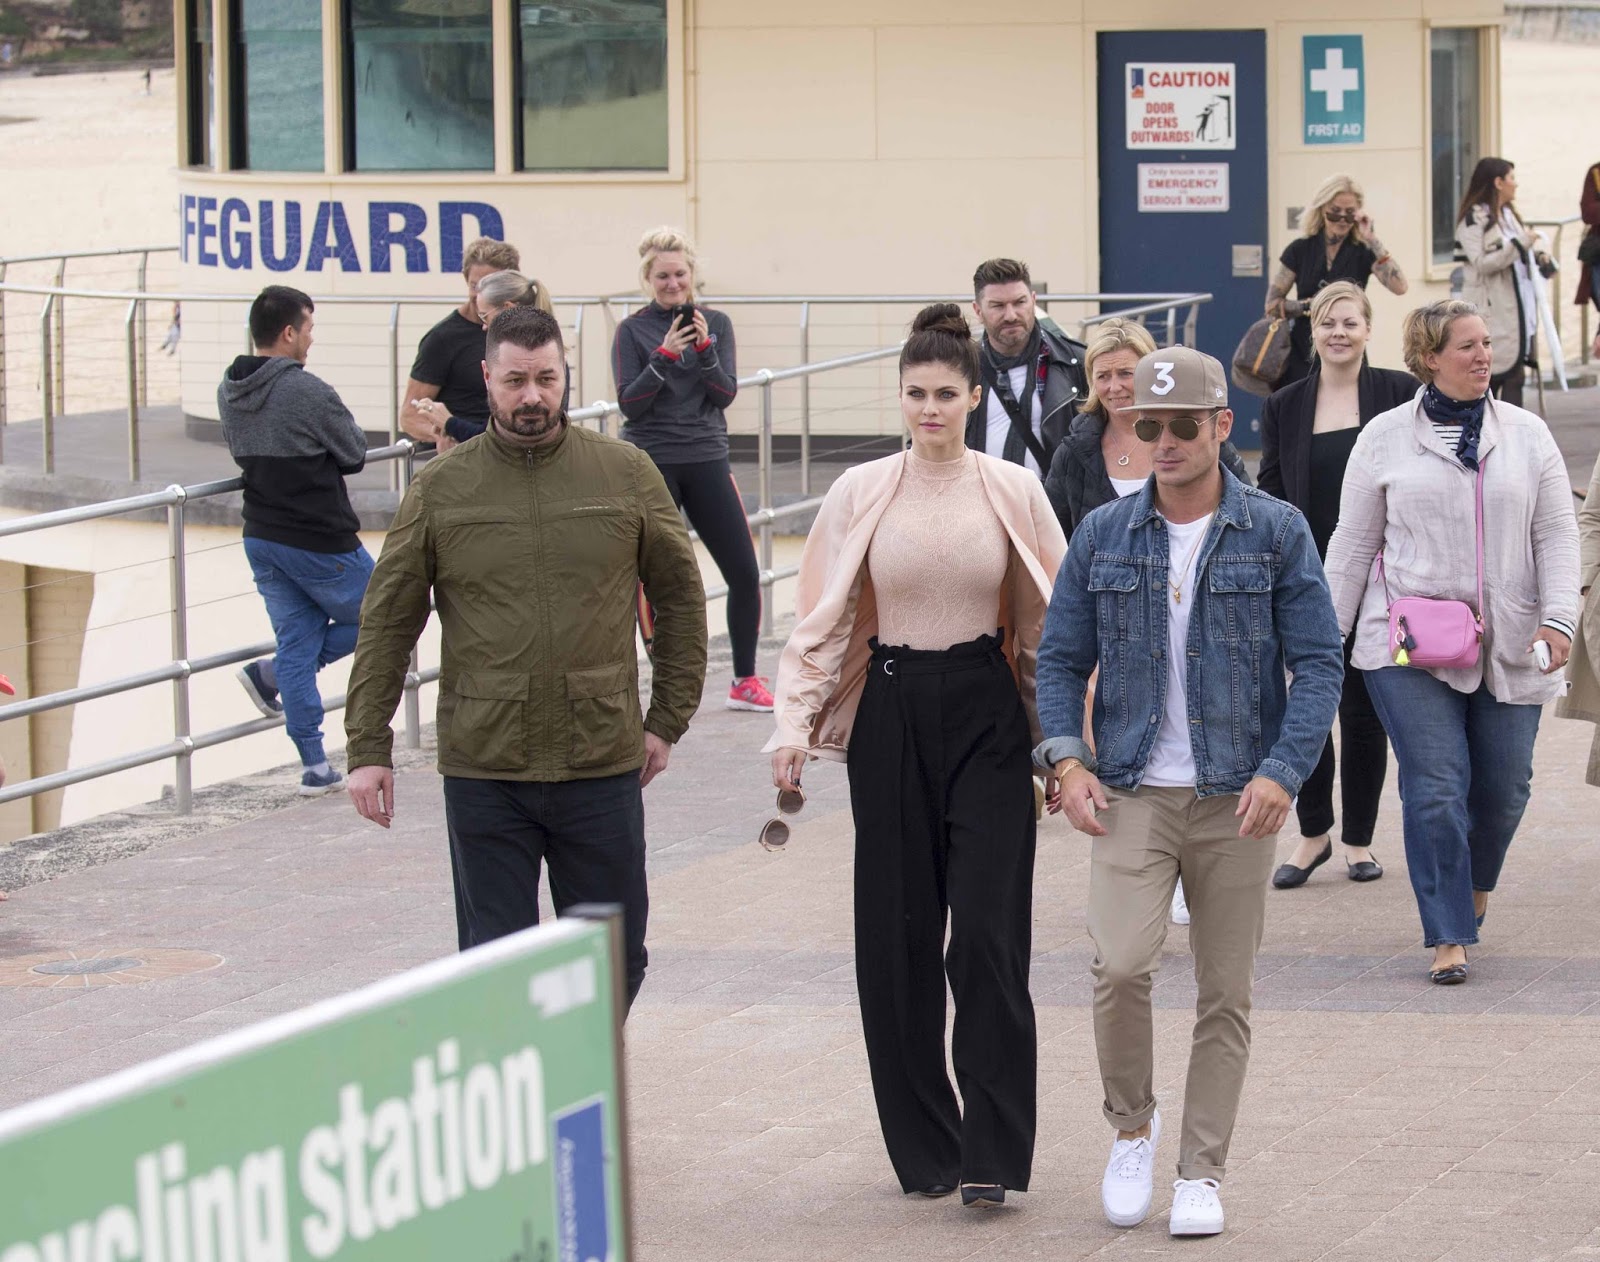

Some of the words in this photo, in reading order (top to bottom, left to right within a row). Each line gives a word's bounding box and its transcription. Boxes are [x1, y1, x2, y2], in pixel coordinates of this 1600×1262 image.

[1148, 71, 1230, 88] CAUTION
[1145, 102, 1175, 114] DOOR
[1142, 117, 1178, 129] OPENS
[1307, 123, 1340, 137] FIRST
[1342, 122, 1362, 136] AID
[1131, 131, 1194, 143] OUTWARDS!
[1147, 167, 1168, 177] Only
[1147, 179, 1219, 189] EMERGENCY
[1143, 195, 1183, 205] SERIOUS
[1186, 195, 1224, 205] INQUIRY
[1150, 362, 1176, 395] 3
[2, 1141, 290, 1262] ling
[299, 1036, 548, 1259] station
